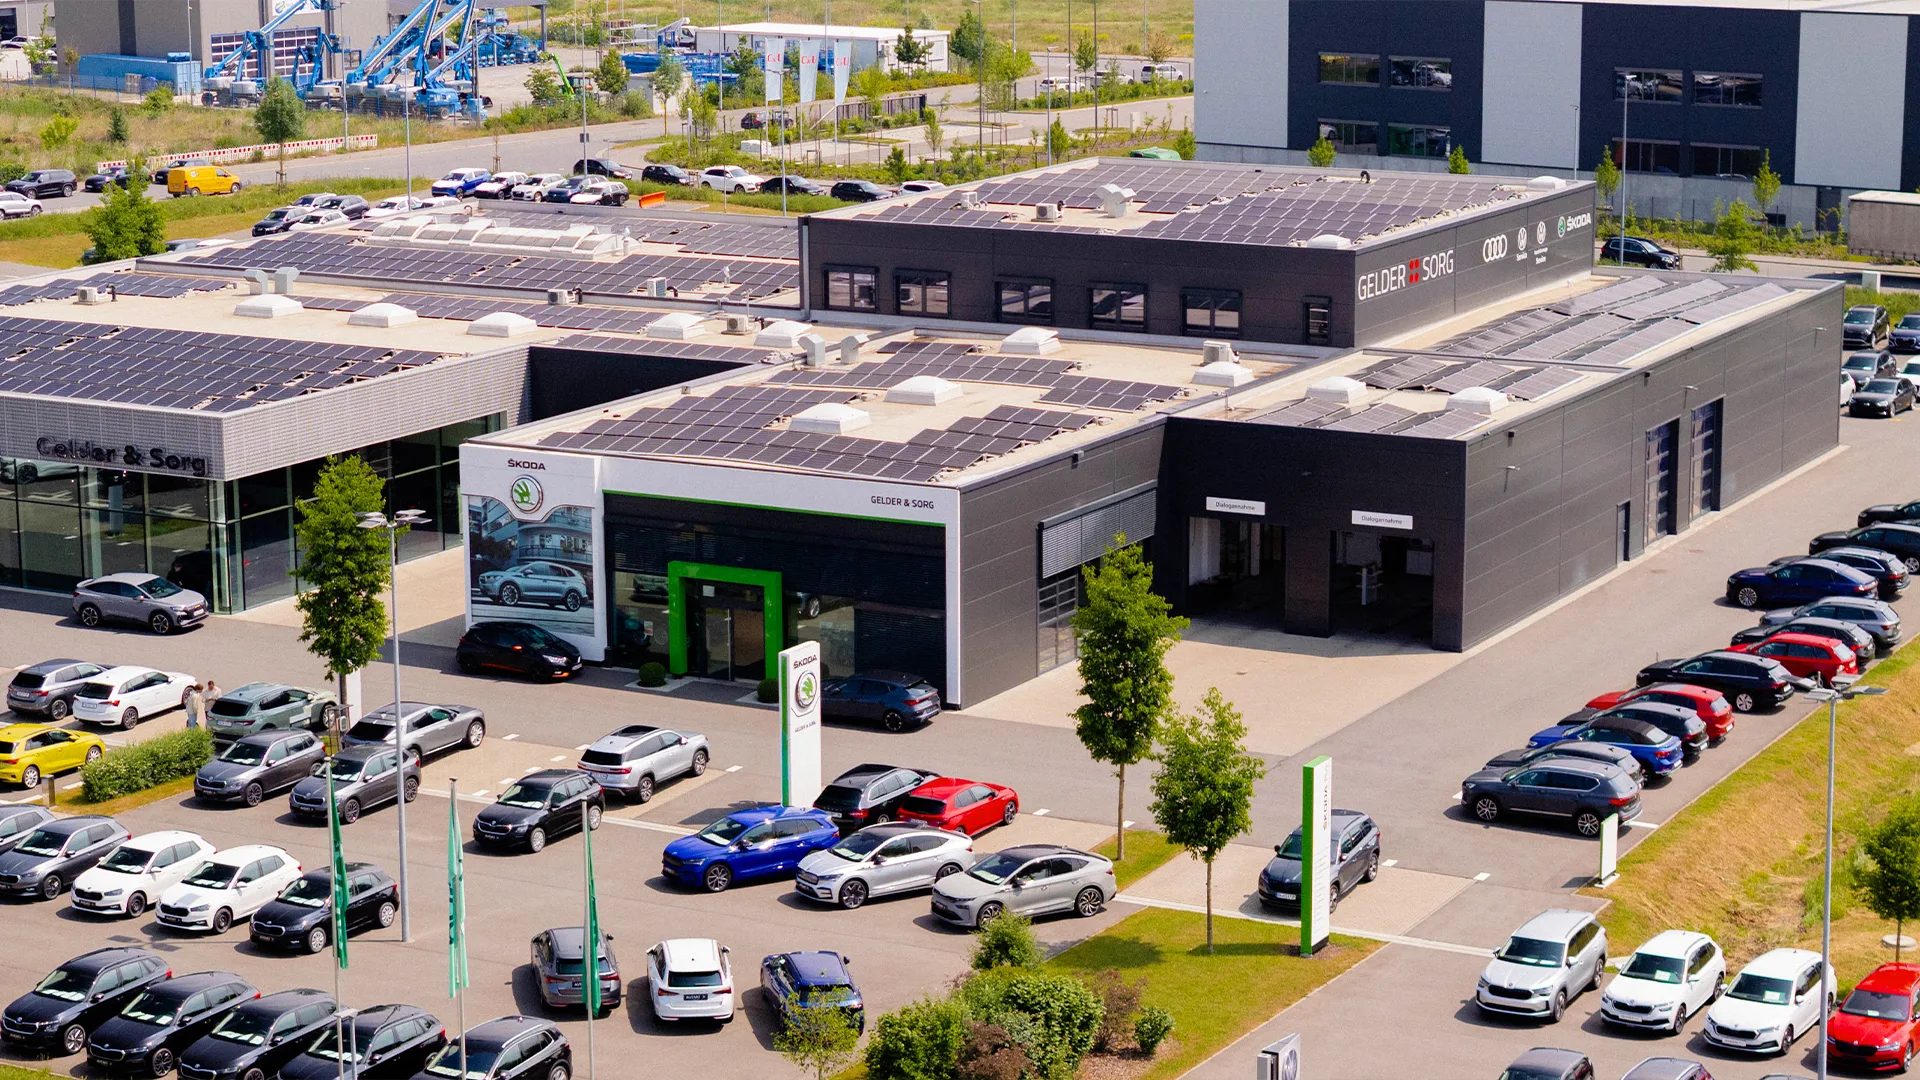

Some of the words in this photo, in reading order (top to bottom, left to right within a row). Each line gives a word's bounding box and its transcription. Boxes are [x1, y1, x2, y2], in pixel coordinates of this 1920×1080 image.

[1567, 212, 1592, 232] ŠKODA
[1357, 264, 1406, 301] GELDER
[1422, 249, 1454, 281] SORG
[36, 437, 116, 464] Gelder
[123, 445, 144, 466] &
[149, 447, 207, 478] Sorg
[507, 458, 546, 471] ŠKODA
[870, 495, 902, 507] GELDER
[903, 498, 910, 508] &
[911, 499, 935, 510] SORG
[1215, 501, 1256, 511] Dialogannahme
[1361, 515, 1403, 525] Dialogannahme
[793, 654, 818, 670] ŠKODA
